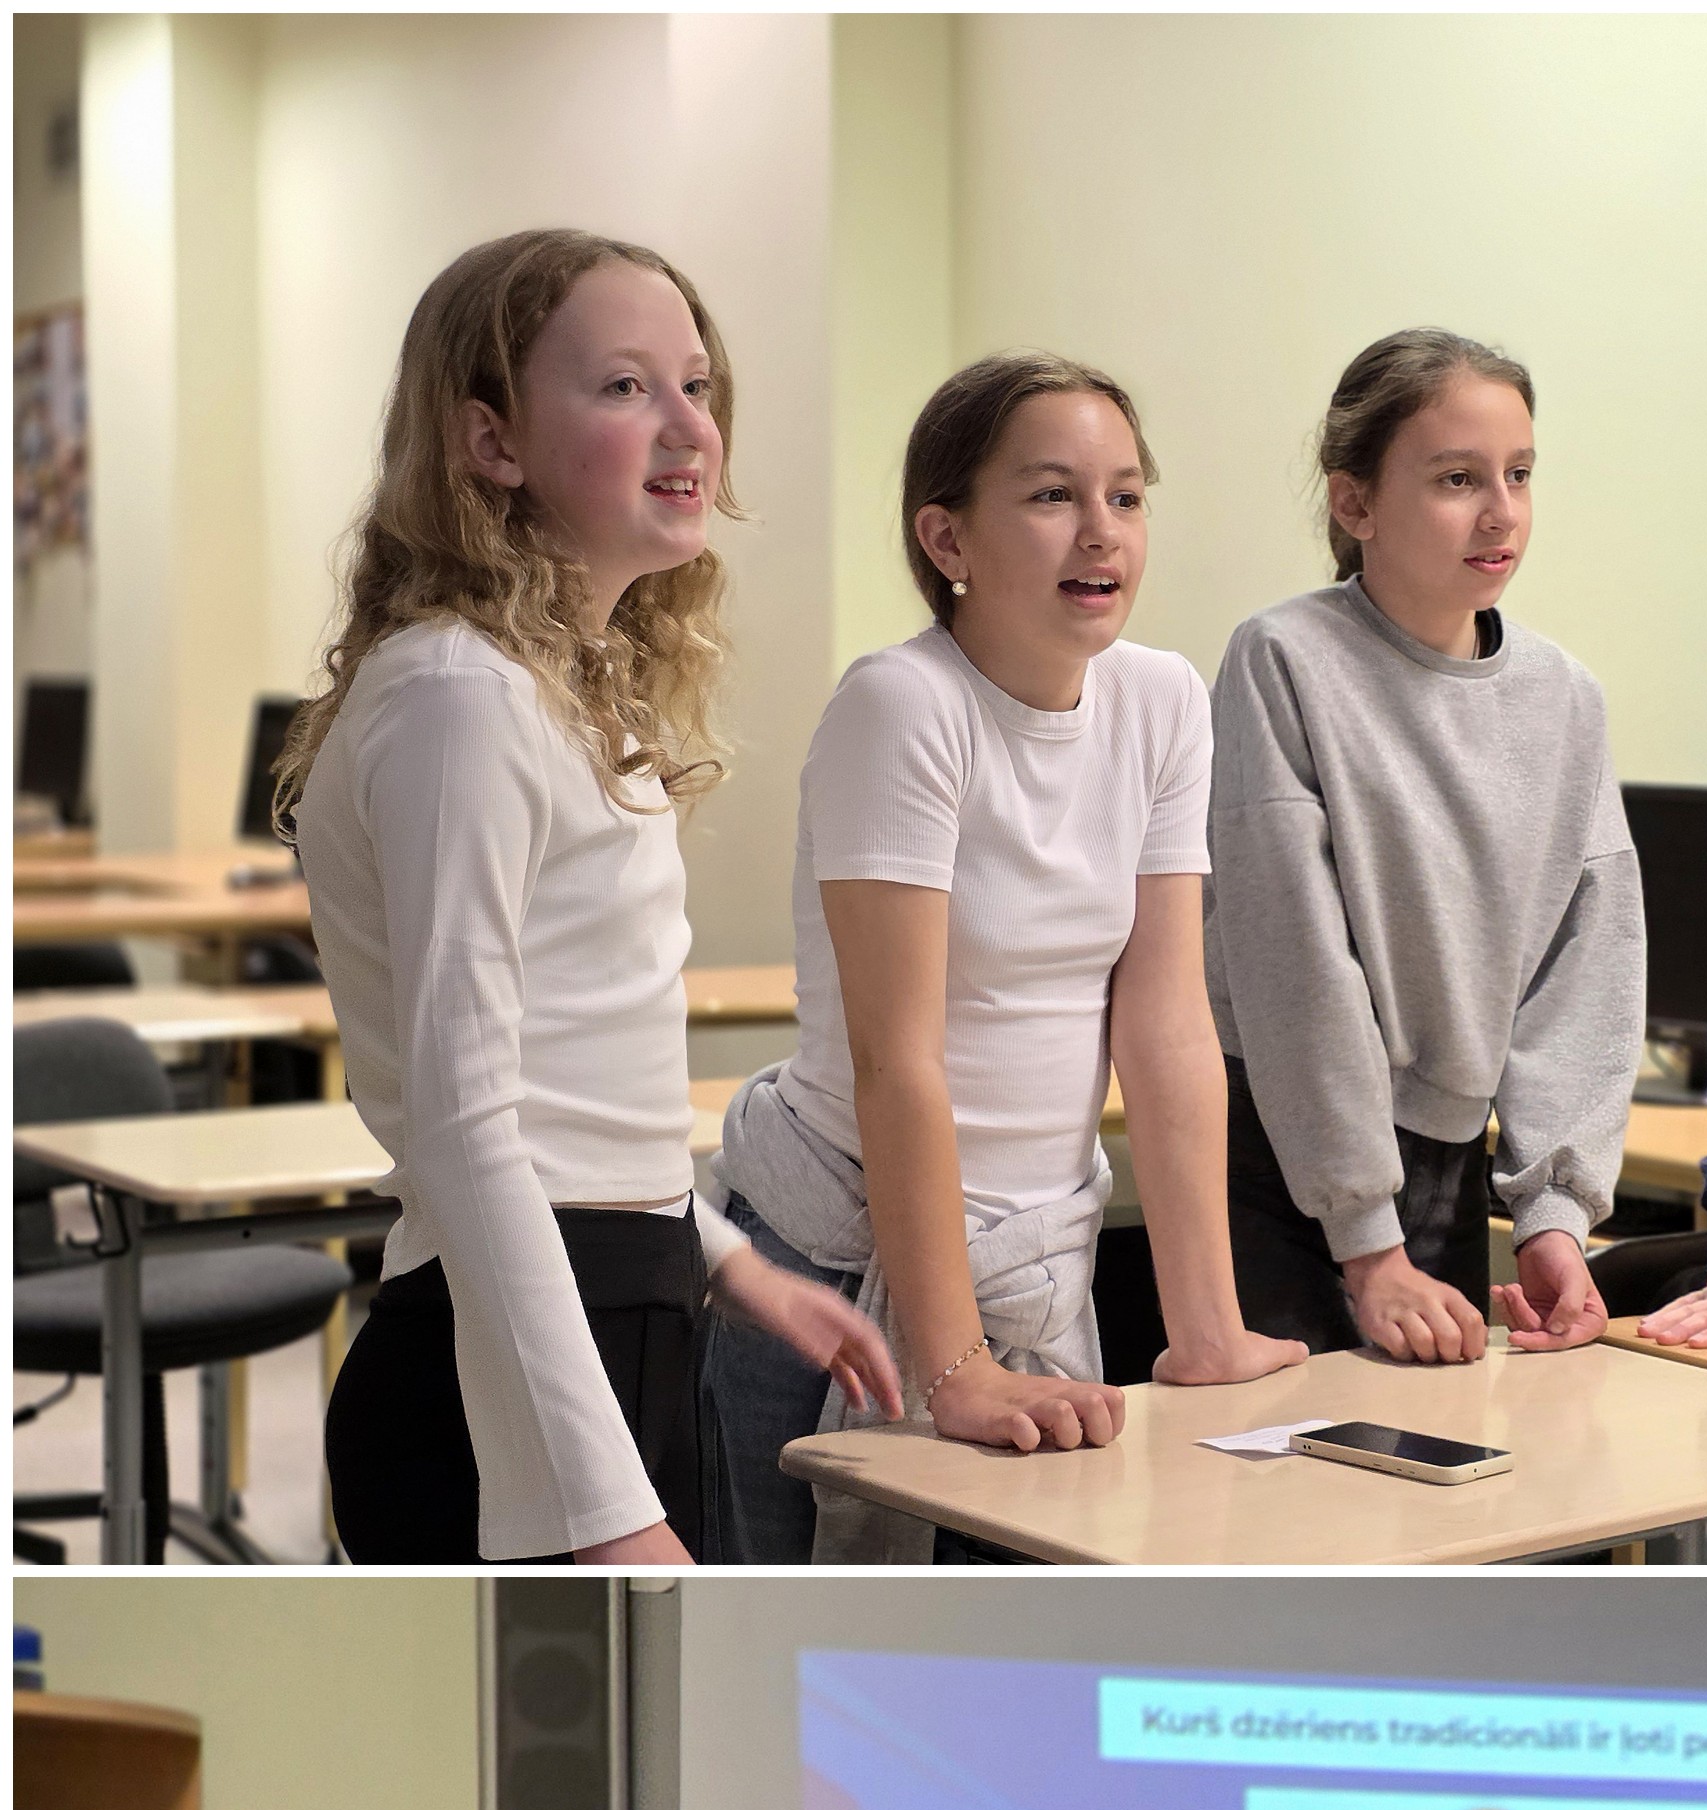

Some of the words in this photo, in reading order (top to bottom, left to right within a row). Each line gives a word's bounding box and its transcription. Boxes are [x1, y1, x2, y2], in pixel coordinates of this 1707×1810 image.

[1141, 1703, 1222, 1738] Kurš
[1230, 1706, 1380, 1744] dzēriens
[1387, 1714, 1580, 1752] tradicionāli
[1587, 1720, 1610, 1750] ir
